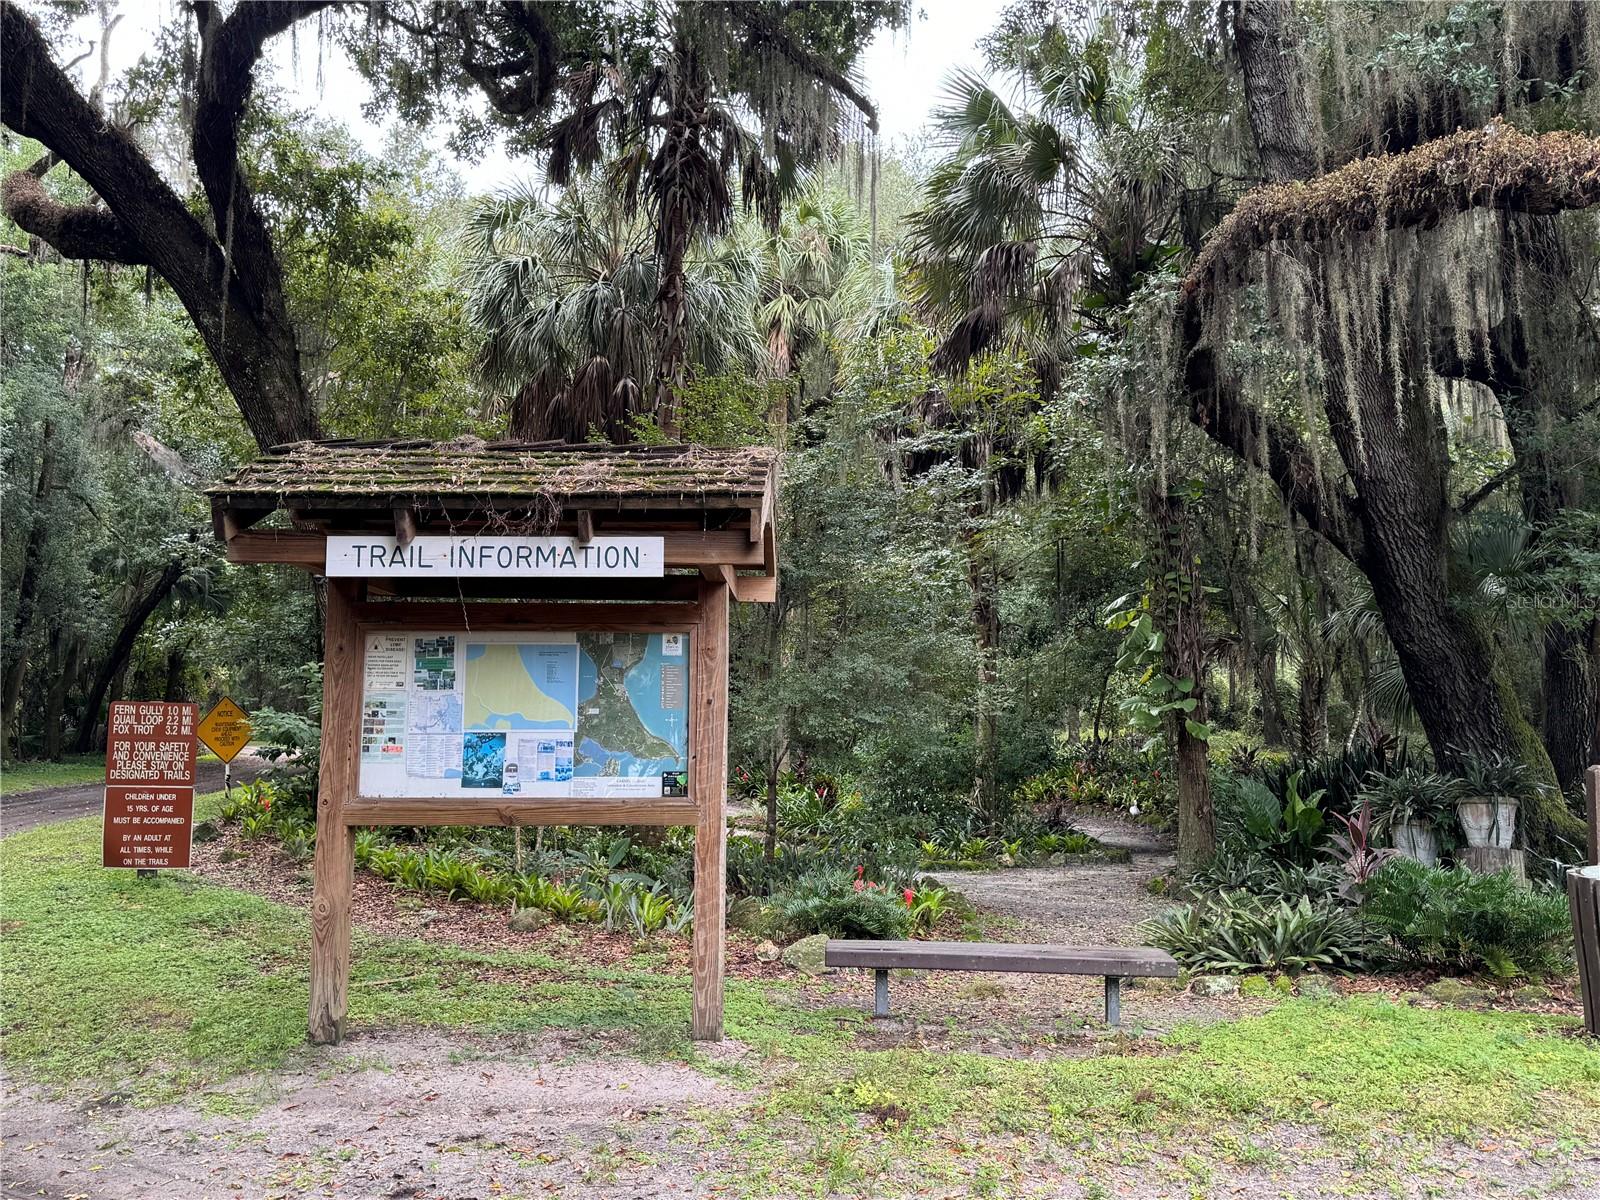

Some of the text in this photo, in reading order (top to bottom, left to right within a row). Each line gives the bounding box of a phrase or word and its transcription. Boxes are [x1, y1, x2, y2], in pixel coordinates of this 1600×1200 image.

[352, 545, 639, 569] TRAIL INFORMATION
[114, 704, 193, 716] FERN GULLY 1.0 MI.
[113, 714, 193, 726] QUAIL LOOP 2.2 MI.
[113, 724, 192, 735] FOX TROT 3.2 MI.
[113, 741, 190, 752] FOR YOUR SAFETY
[112, 751, 190, 761] AND CONVENIENCE
[116, 760, 185, 771] PLEASE STAY ON
[109, 769, 191, 780] DESIGNATED TRAILS
[125, 792, 155, 800] CHILDREN
